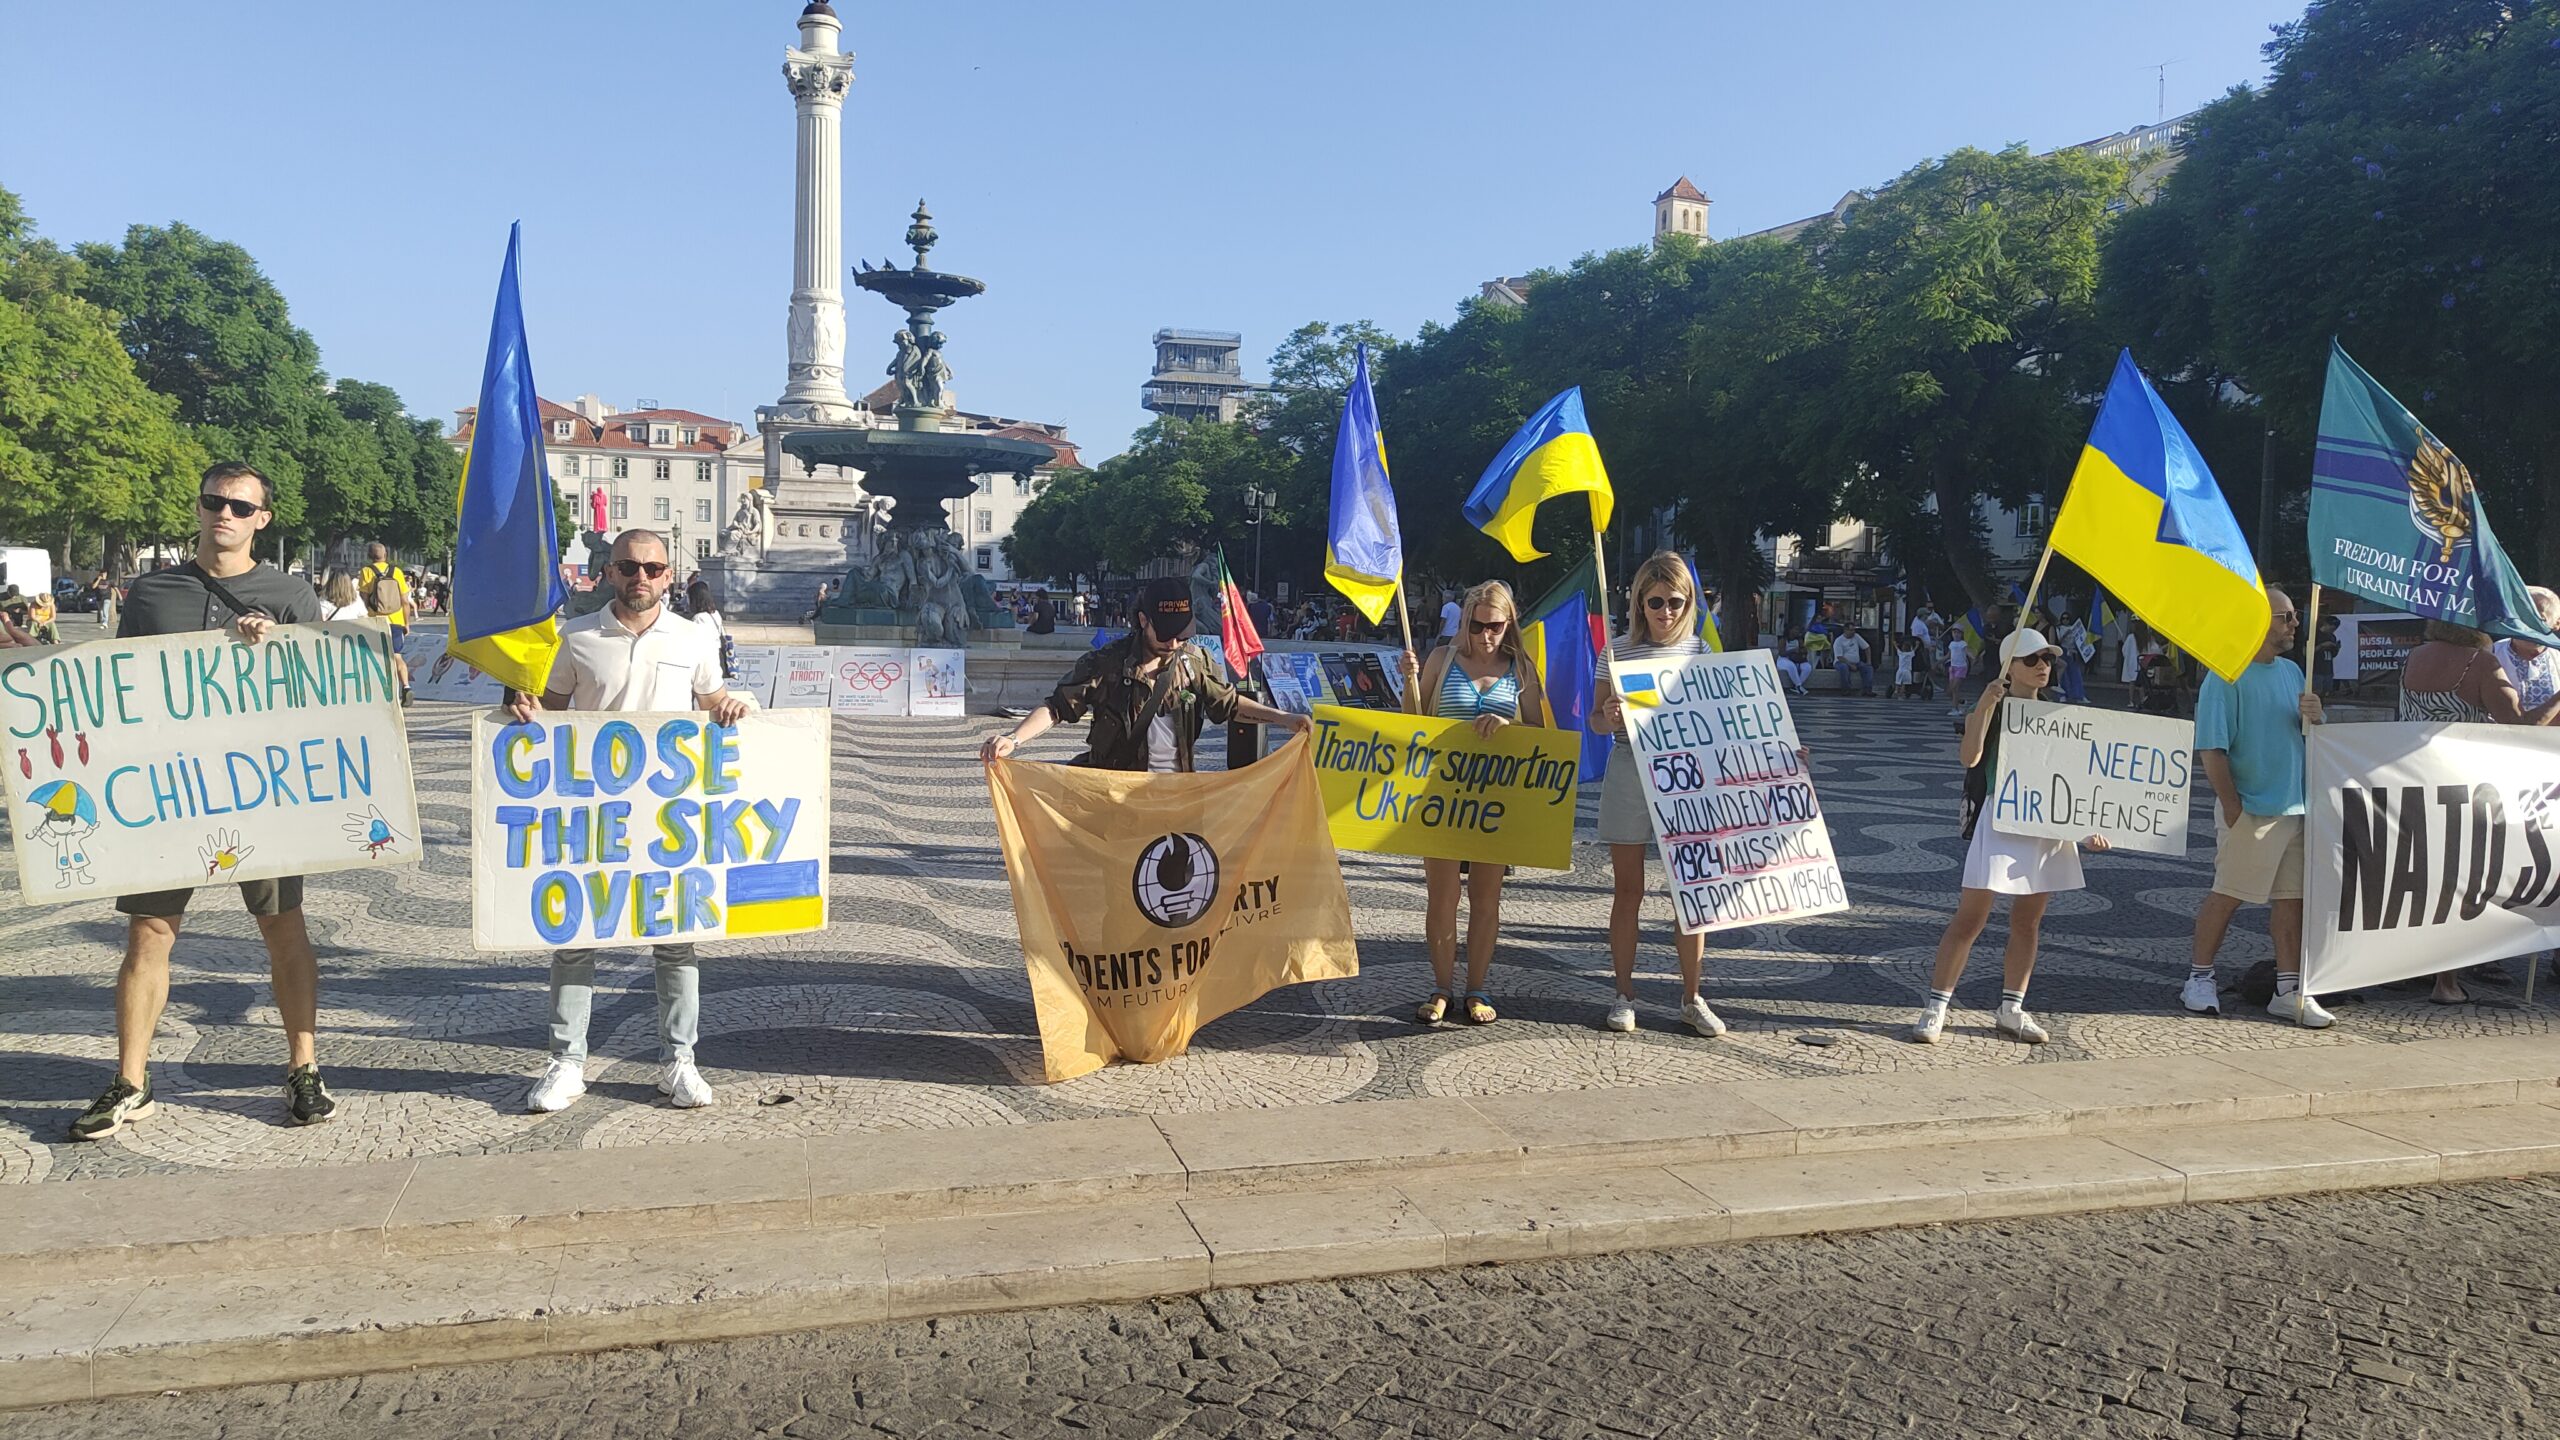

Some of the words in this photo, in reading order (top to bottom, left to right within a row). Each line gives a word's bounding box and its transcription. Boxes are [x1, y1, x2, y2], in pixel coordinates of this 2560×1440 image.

[2334, 538, 2406, 574] FREEDOM
[2409, 560, 2458, 586] FOR
[2347, 567, 2442, 608] UKRAINIAN
[2359, 637, 2392, 646] RUSSIA
[2359, 649, 2392, 658] PEOPLE
[2393, 649, 2411, 658] AN
[2359, 661, 2399, 670] ANIMALS
[2, 652, 137, 739] SAVE
[790, 670, 825, 682] ATROCITY
[1634, 709, 1713, 752] NEED
[1720, 701, 1784, 741] HELP
[491, 719, 742, 799] CLOSE
[1314, 719, 1397, 776] Thanks
[1404, 731, 1440, 779] for
[1440, 744, 1577, 805] supporting
[1653, 752, 1704, 794] 568
[2088, 740, 2188, 788] NEEDS
[1355, 778, 1505, 834] Ukraine
[1654, 789, 1771, 837] WOUNDED
[495, 800, 632, 869] THE
[647, 797, 801, 868] SKY
[2338, 782, 2507, 931] NATO
[1673, 841, 1725, 883] 1924
[531, 866, 722, 945] OVER
[1679, 875, 1789, 927] DEPORTED
[1123, 983, 1194, 1008] FUTUR
